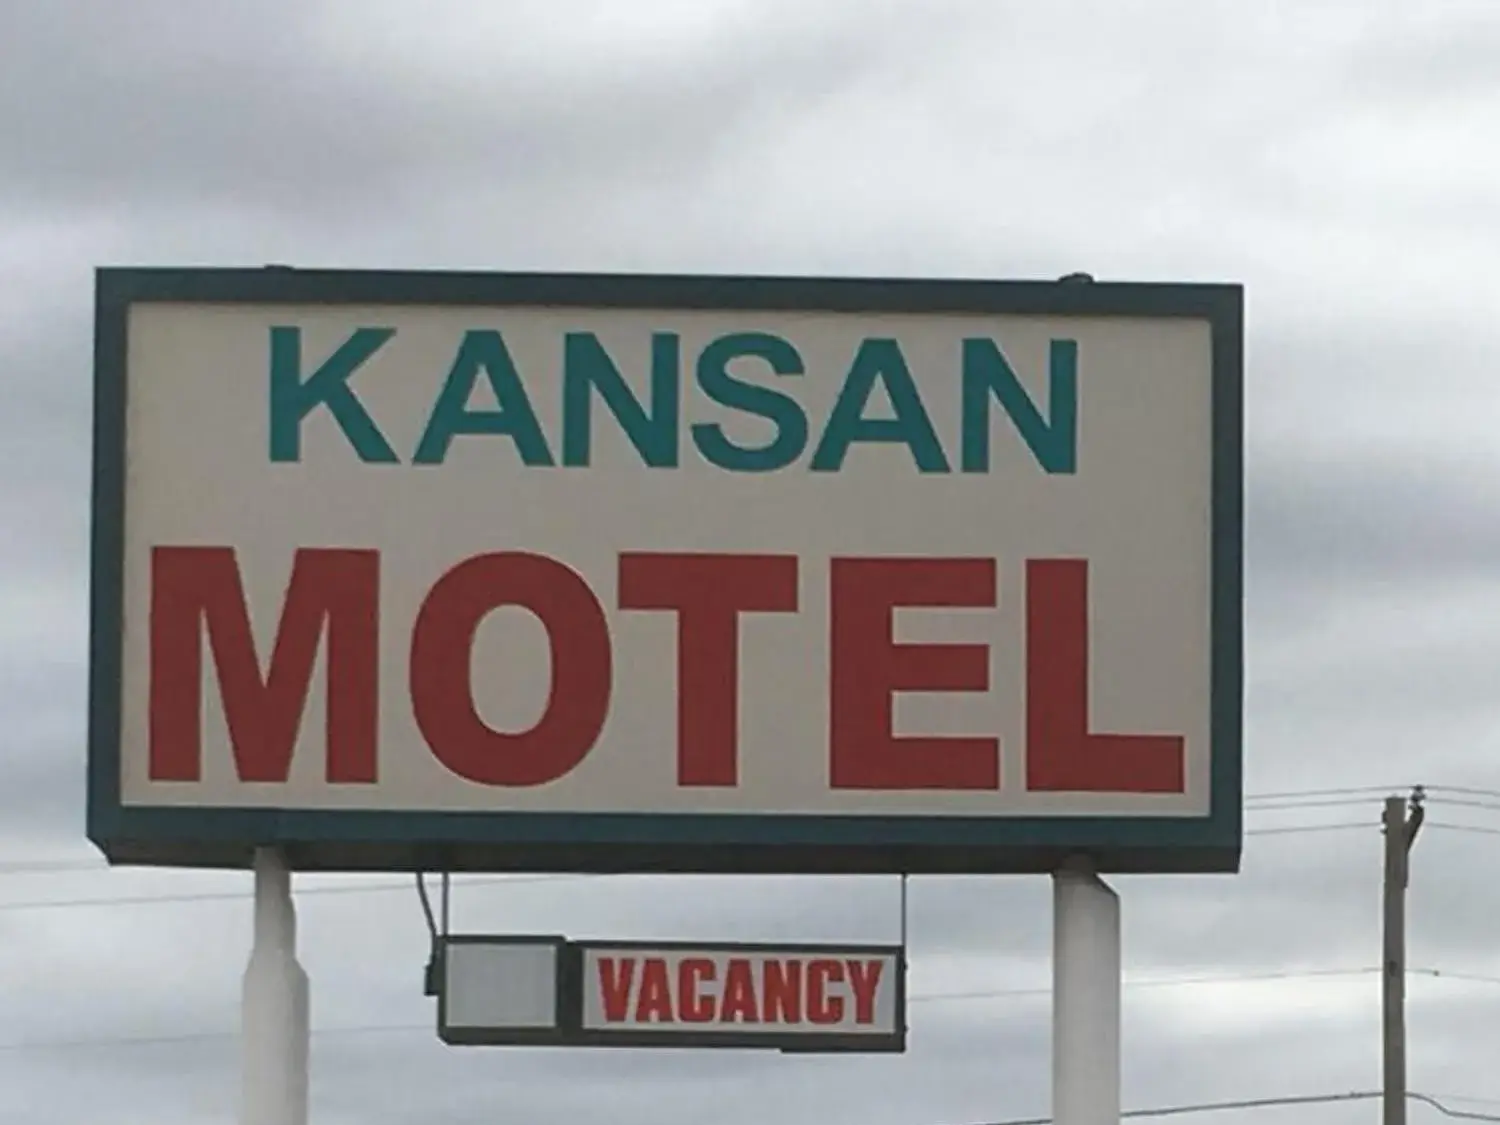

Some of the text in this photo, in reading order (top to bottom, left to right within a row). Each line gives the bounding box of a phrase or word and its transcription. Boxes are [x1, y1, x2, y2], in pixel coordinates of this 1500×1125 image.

[268, 325, 1079, 475] KANSAN
[148, 545, 1185, 793] MOTEL
[597, 957, 883, 1025] VACANCY
